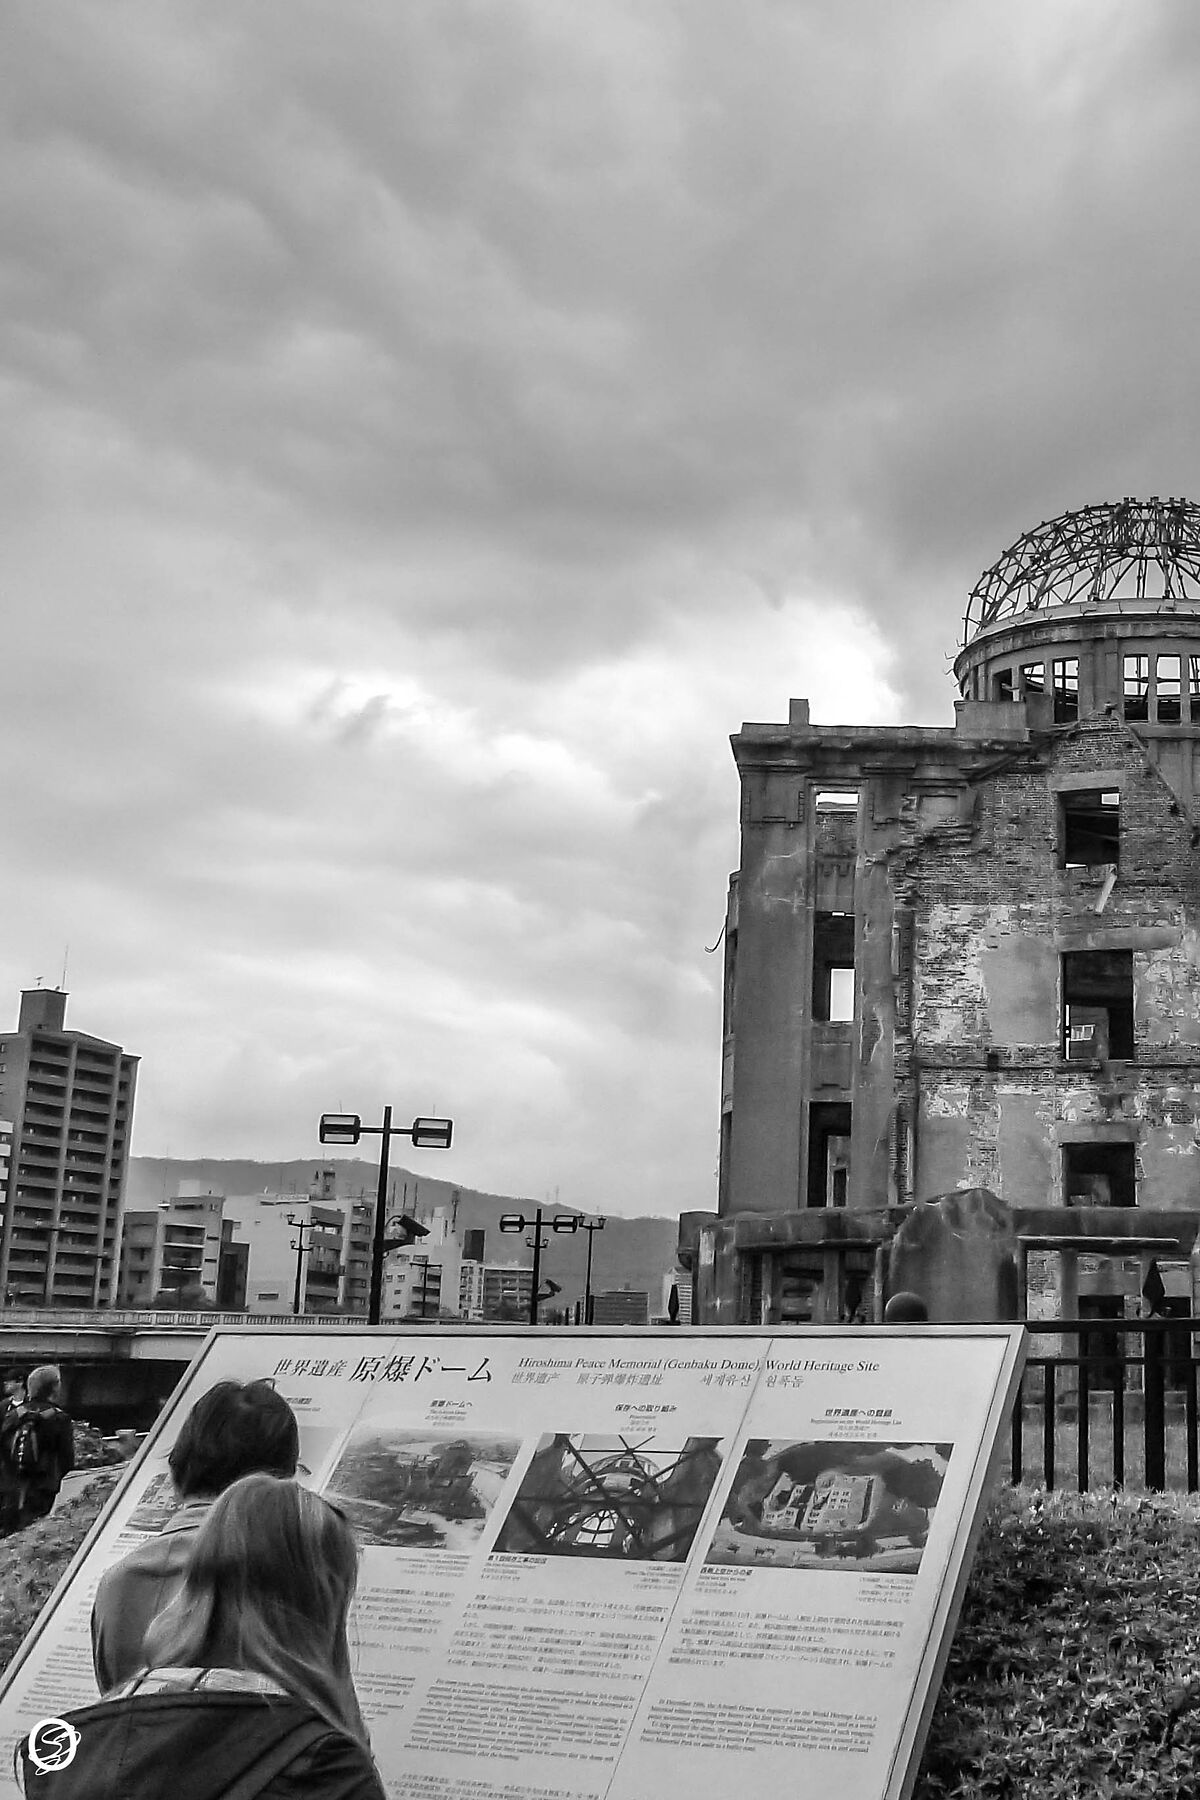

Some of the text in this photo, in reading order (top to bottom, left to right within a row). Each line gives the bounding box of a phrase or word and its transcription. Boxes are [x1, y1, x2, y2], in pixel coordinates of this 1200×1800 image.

[272, 1355, 494, 1383] 世界遺産 原爆ドーム
[518, 1357, 880, 1374] Hiroshima Peace Memorial (Genbaku Dome), World Heritage Site
